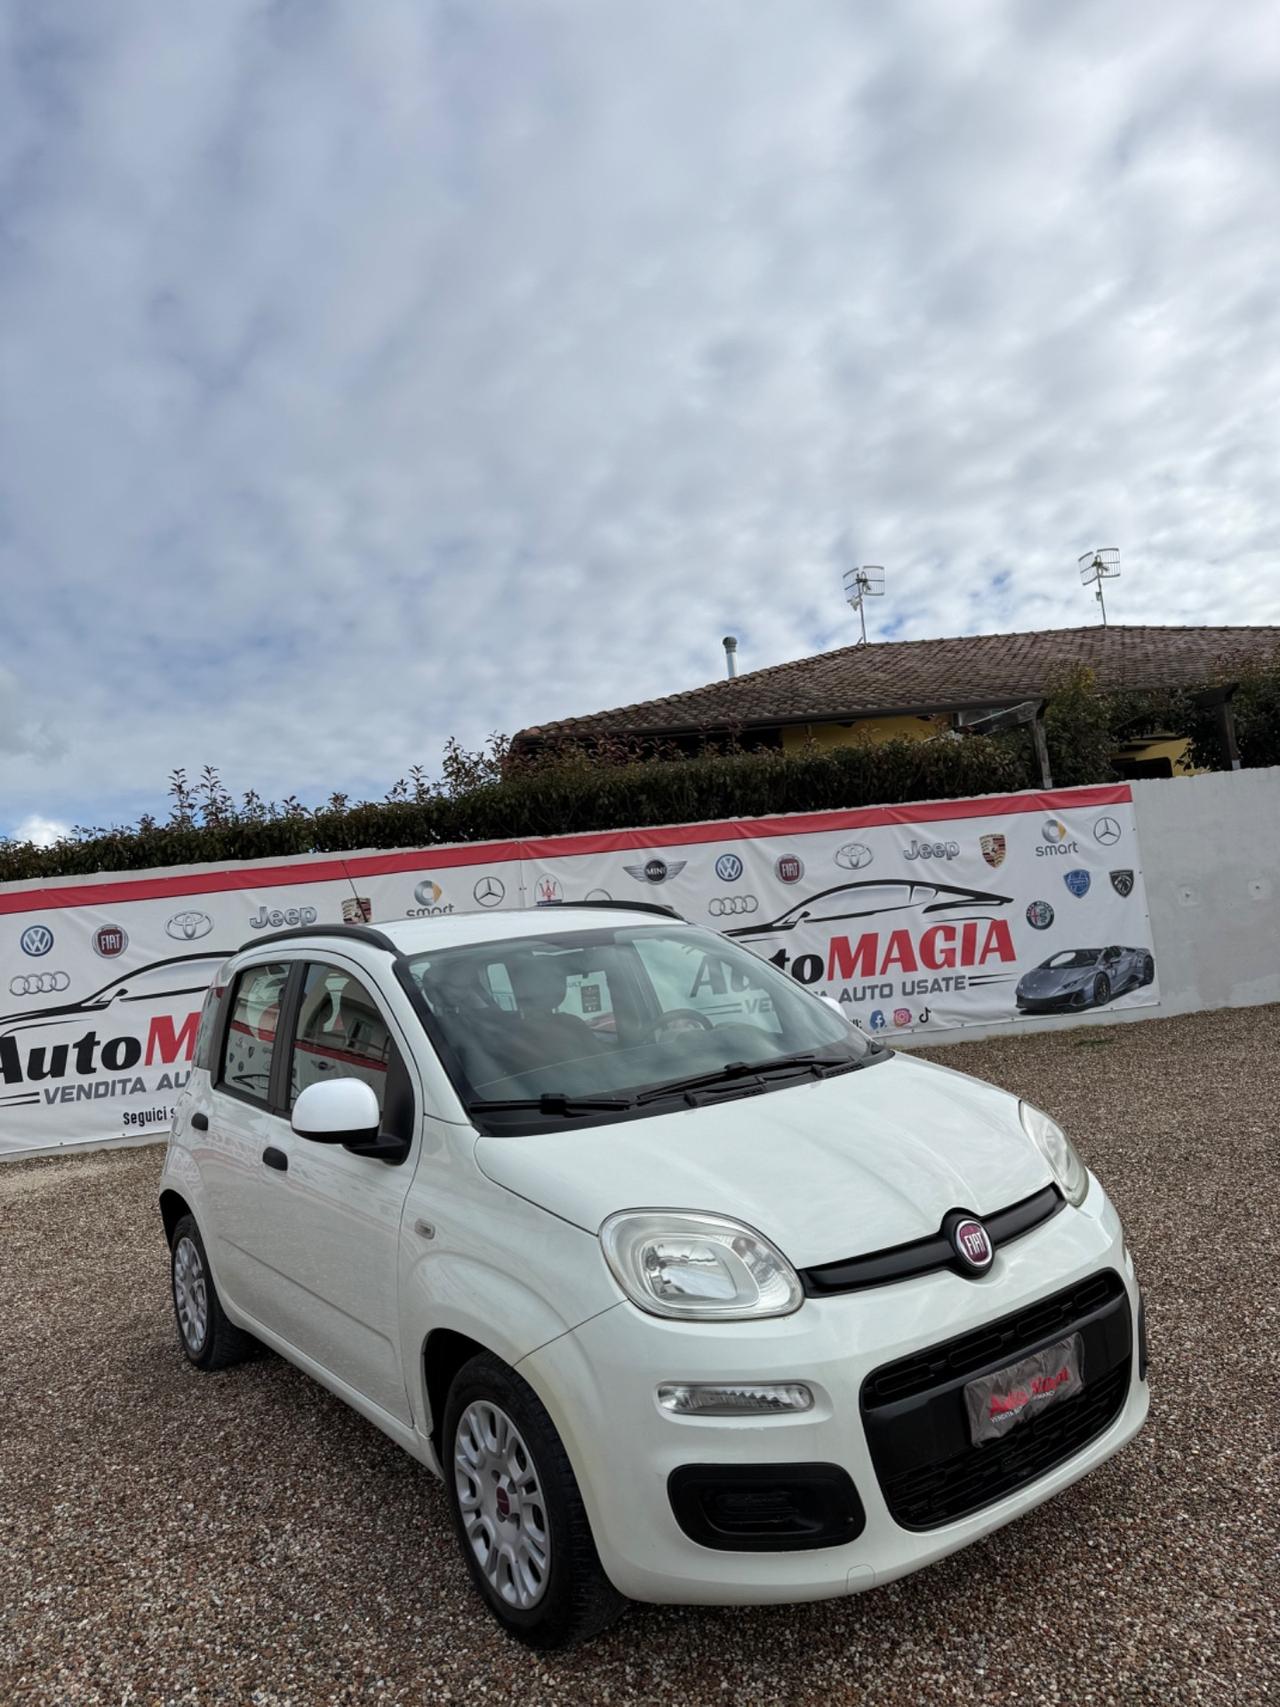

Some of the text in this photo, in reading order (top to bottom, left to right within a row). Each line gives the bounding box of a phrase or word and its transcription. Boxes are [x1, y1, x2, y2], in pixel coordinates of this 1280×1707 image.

[903, 839, 961, 861] Jeep
[1035, 841, 1079, 857] smart
[781, 861, 800, 878] FIAT
[250, 905, 318, 929] Jeep
[100, 932, 121, 951] FIAT
[838, 975, 967, 1004] AUTO USATE
[0, 1011, 202, 1085] AutoM
[44, 1070, 191, 1105] VENDITA AU
[123, 1106, 167, 1127] Seguici
[964, 1232, 986, 1255] FIAT
